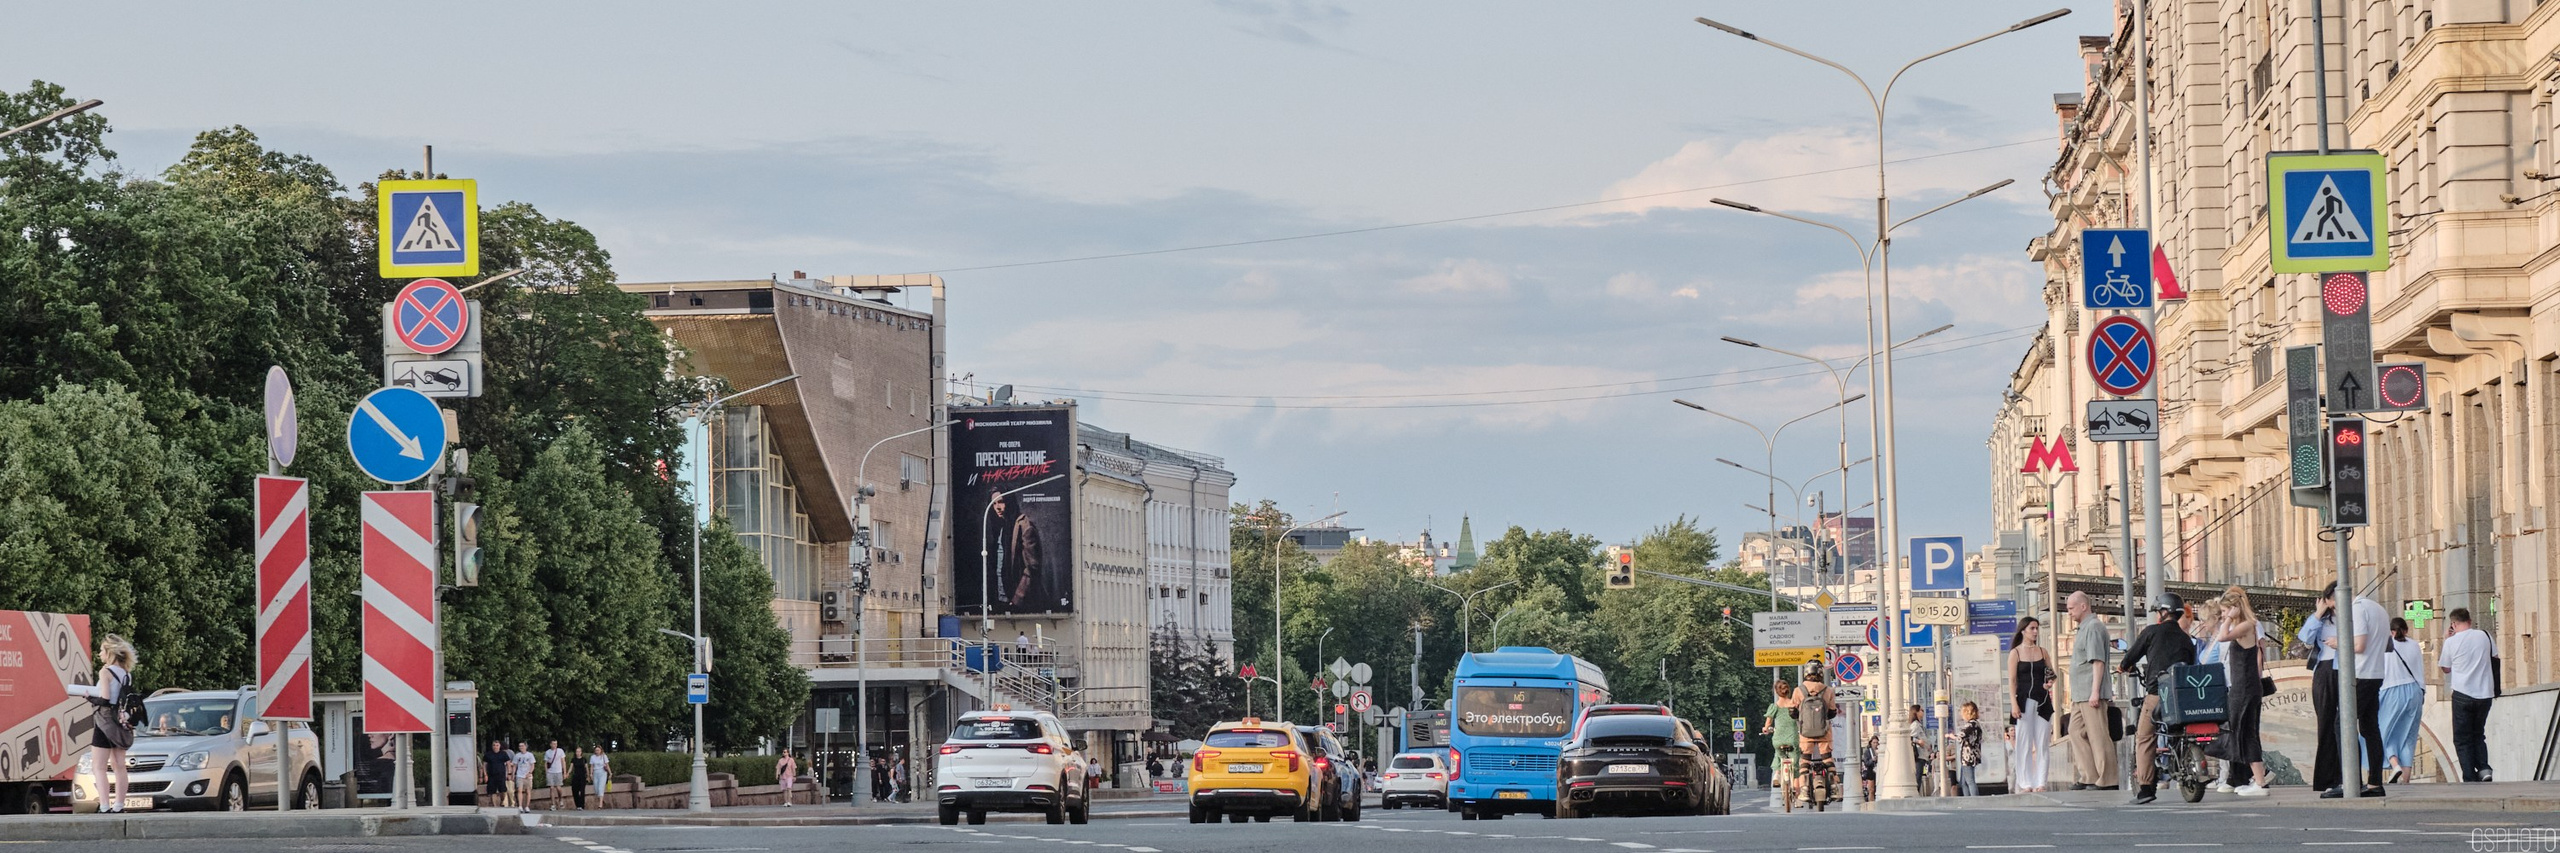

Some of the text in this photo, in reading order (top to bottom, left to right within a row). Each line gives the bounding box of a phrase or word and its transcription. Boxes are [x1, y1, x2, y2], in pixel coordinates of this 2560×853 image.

[975, 450, 1047, 467] ПРЕСТУПЛЕНИЕ
[967, 460, 1056, 485] И НАКАЗАНИЕ
[1925, 542, 1955, 585] P
[1917, 605, 1959, 617] 10 15 20
[1465, 711, 1488, 723] Это
[2184, 707, 2224, 716] YAMIYAMI.RU
